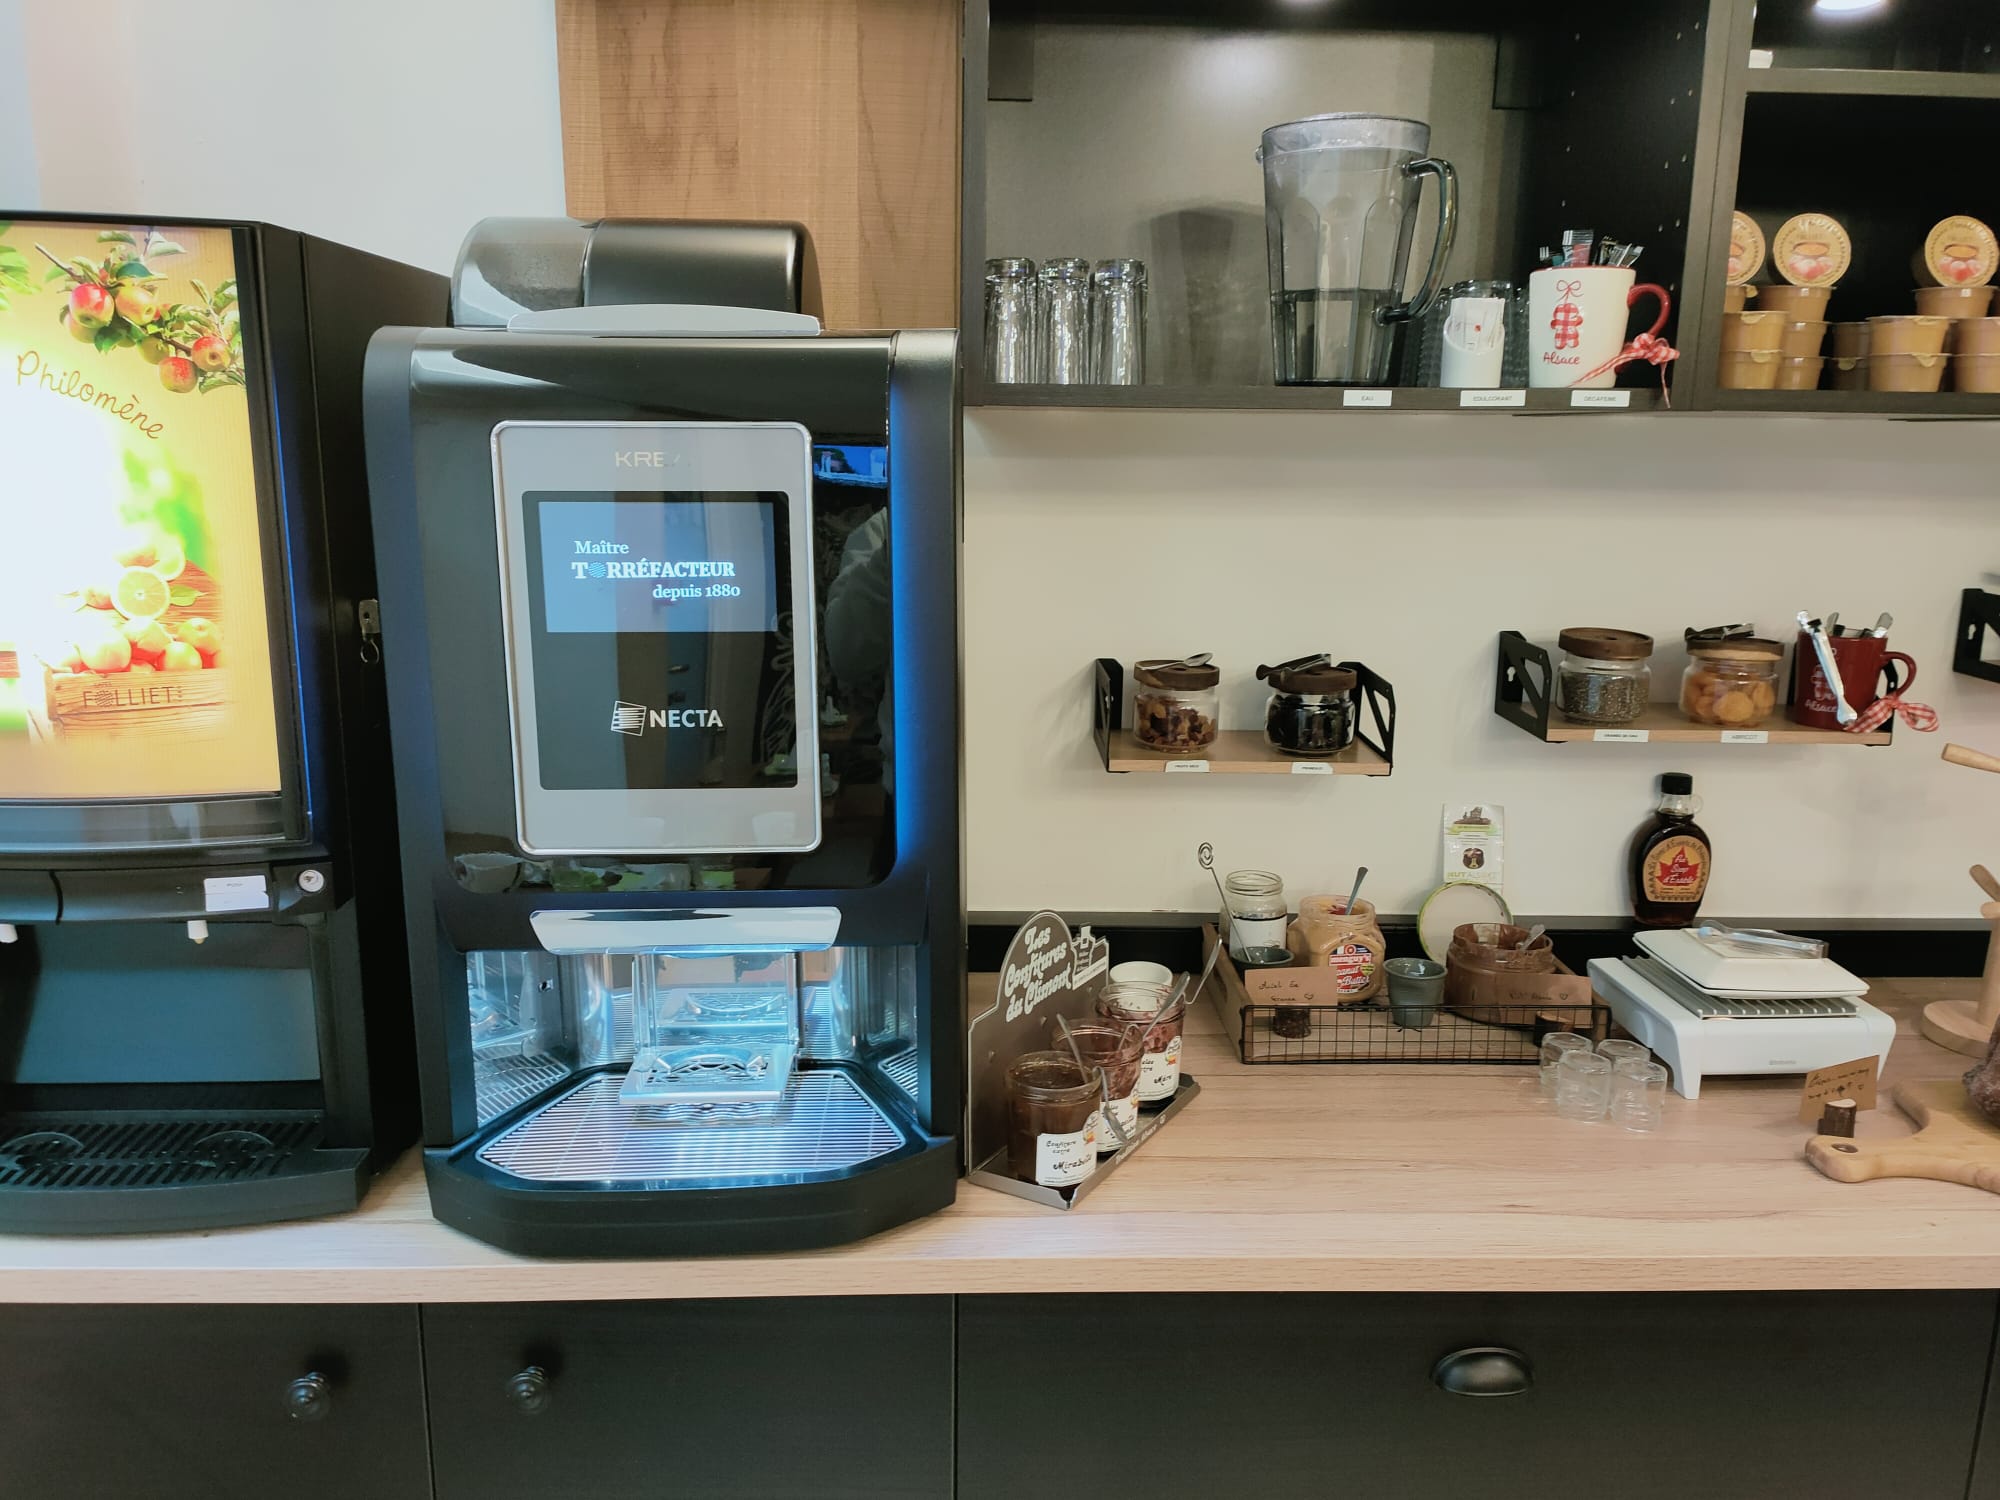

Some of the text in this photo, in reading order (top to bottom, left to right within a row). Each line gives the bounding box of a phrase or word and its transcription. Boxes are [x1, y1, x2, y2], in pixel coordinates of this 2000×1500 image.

[1543, 351, 1581, 365] Alsace
[16, 350, 164, 439] Philomène
[615, 451, 681, 467] KRE
[574, 540, 630, 554] Maître
[571, 557, 736, 579] TORRÉFACTEUR
[652, 583, 741, 601] depuis 1880
[649, 709, 724, 729] NECTA
